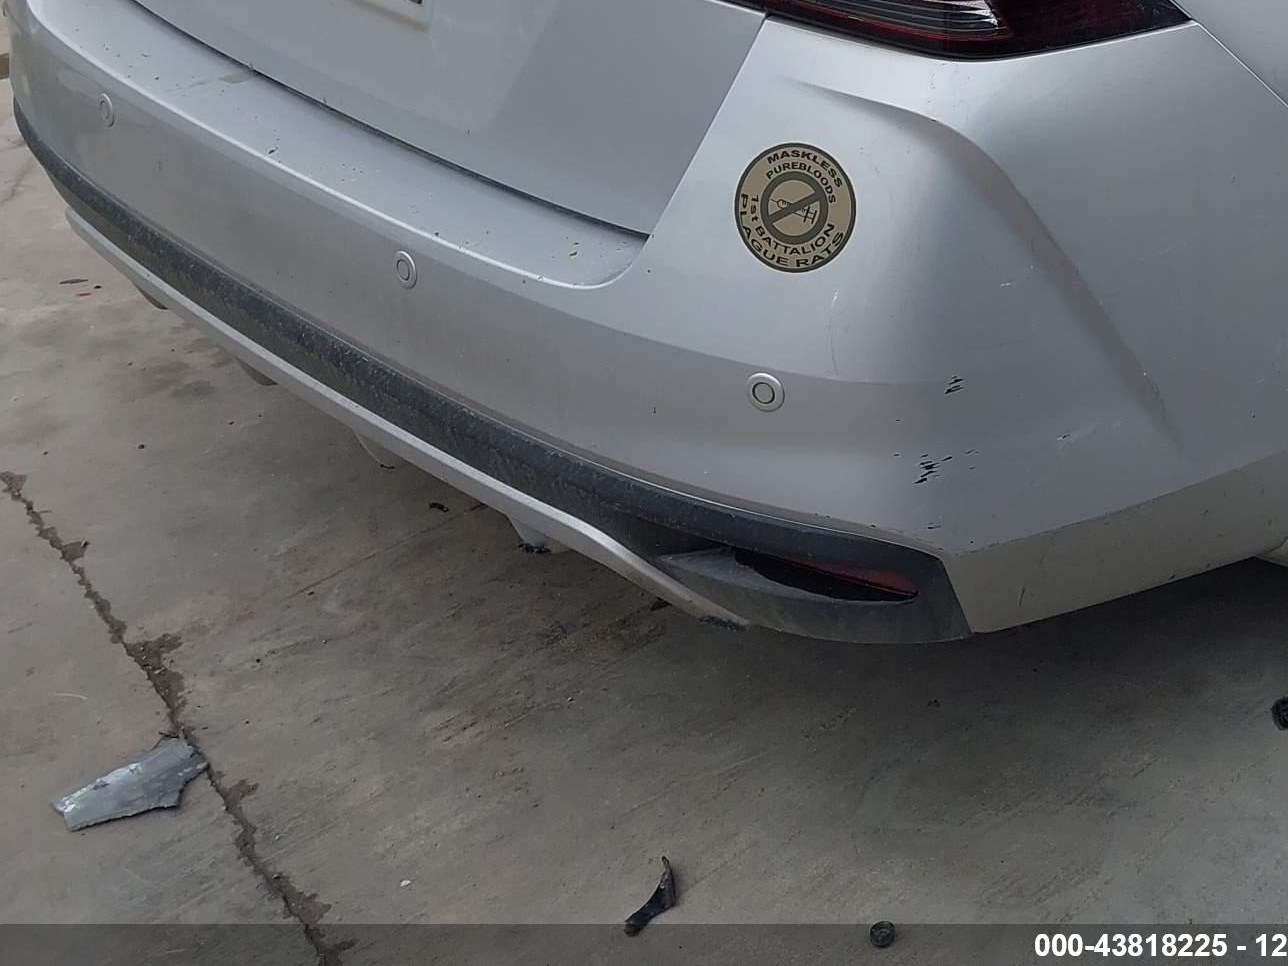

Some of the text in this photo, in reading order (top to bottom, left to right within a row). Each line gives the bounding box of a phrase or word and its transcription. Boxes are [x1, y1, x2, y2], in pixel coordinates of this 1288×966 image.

[765, 161, 836, 204] PUREBLOODS
[766, 149, 843, 188] MASKLESS
[755, 223, 836, 255] BATTALION
[795, 231, 844, 268] RATS
